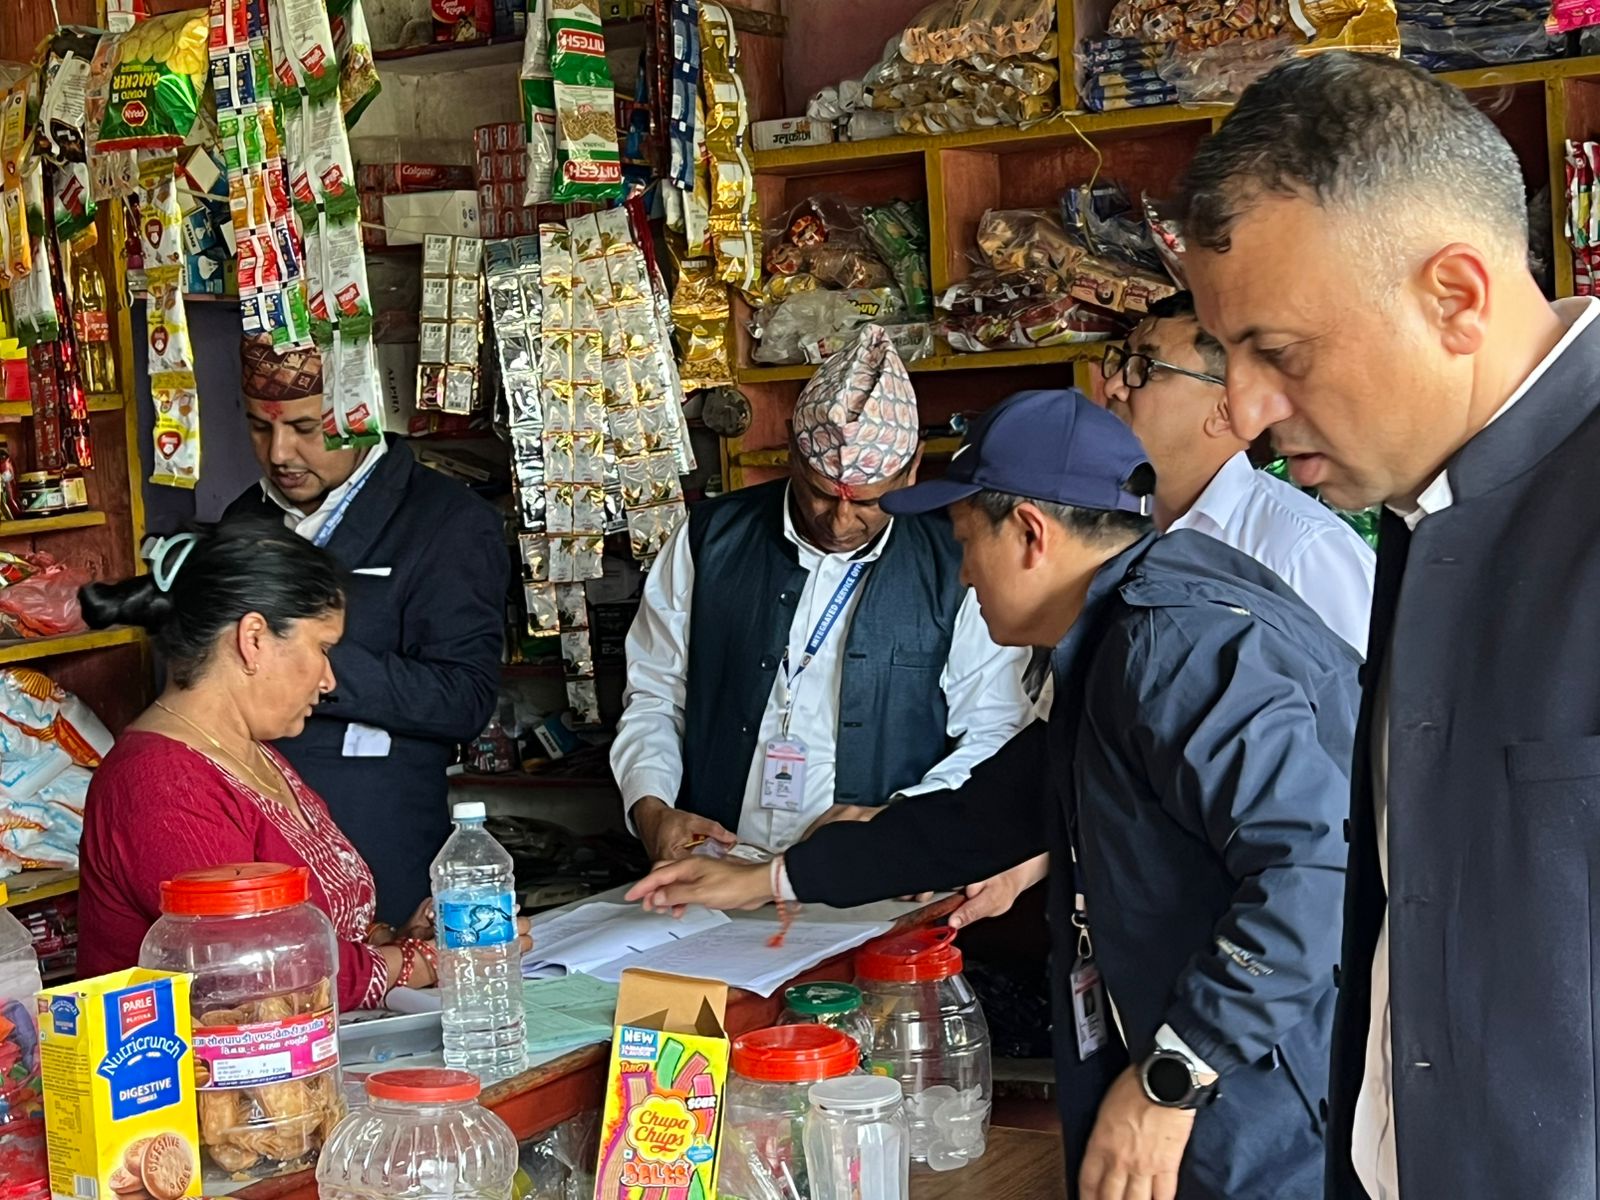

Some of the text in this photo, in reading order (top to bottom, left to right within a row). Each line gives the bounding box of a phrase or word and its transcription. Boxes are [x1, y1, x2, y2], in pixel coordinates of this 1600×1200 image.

[561, 34, 605, 52] NITESH
[113, 72, 160, 90] CRACKER
[120, 89, 148, 100] POTATO
[124, 109, 145, 119] PRAN
[402, 164, 436, 178] Colgate
[568, 162, 620, 179] NITESH
[810, 603, 839, 649] INTEGRATED
[834, 577, 856, 605] SERVICE
[122, 996, 153, 1013] PARLE
[623, 1029, 655, 1044] NEW
[101, 1036, 181, 1076] Nutricrunch
[119, 1077, 172, 1101] DIGESTIVE
[687, 1097, 716, 1109] SOUR
[639, 1110, 690, 1131] Chupa
[635, 1126, 685, 1153] Chups
[149, 1135, 180, 1173] DIGESTIVE
